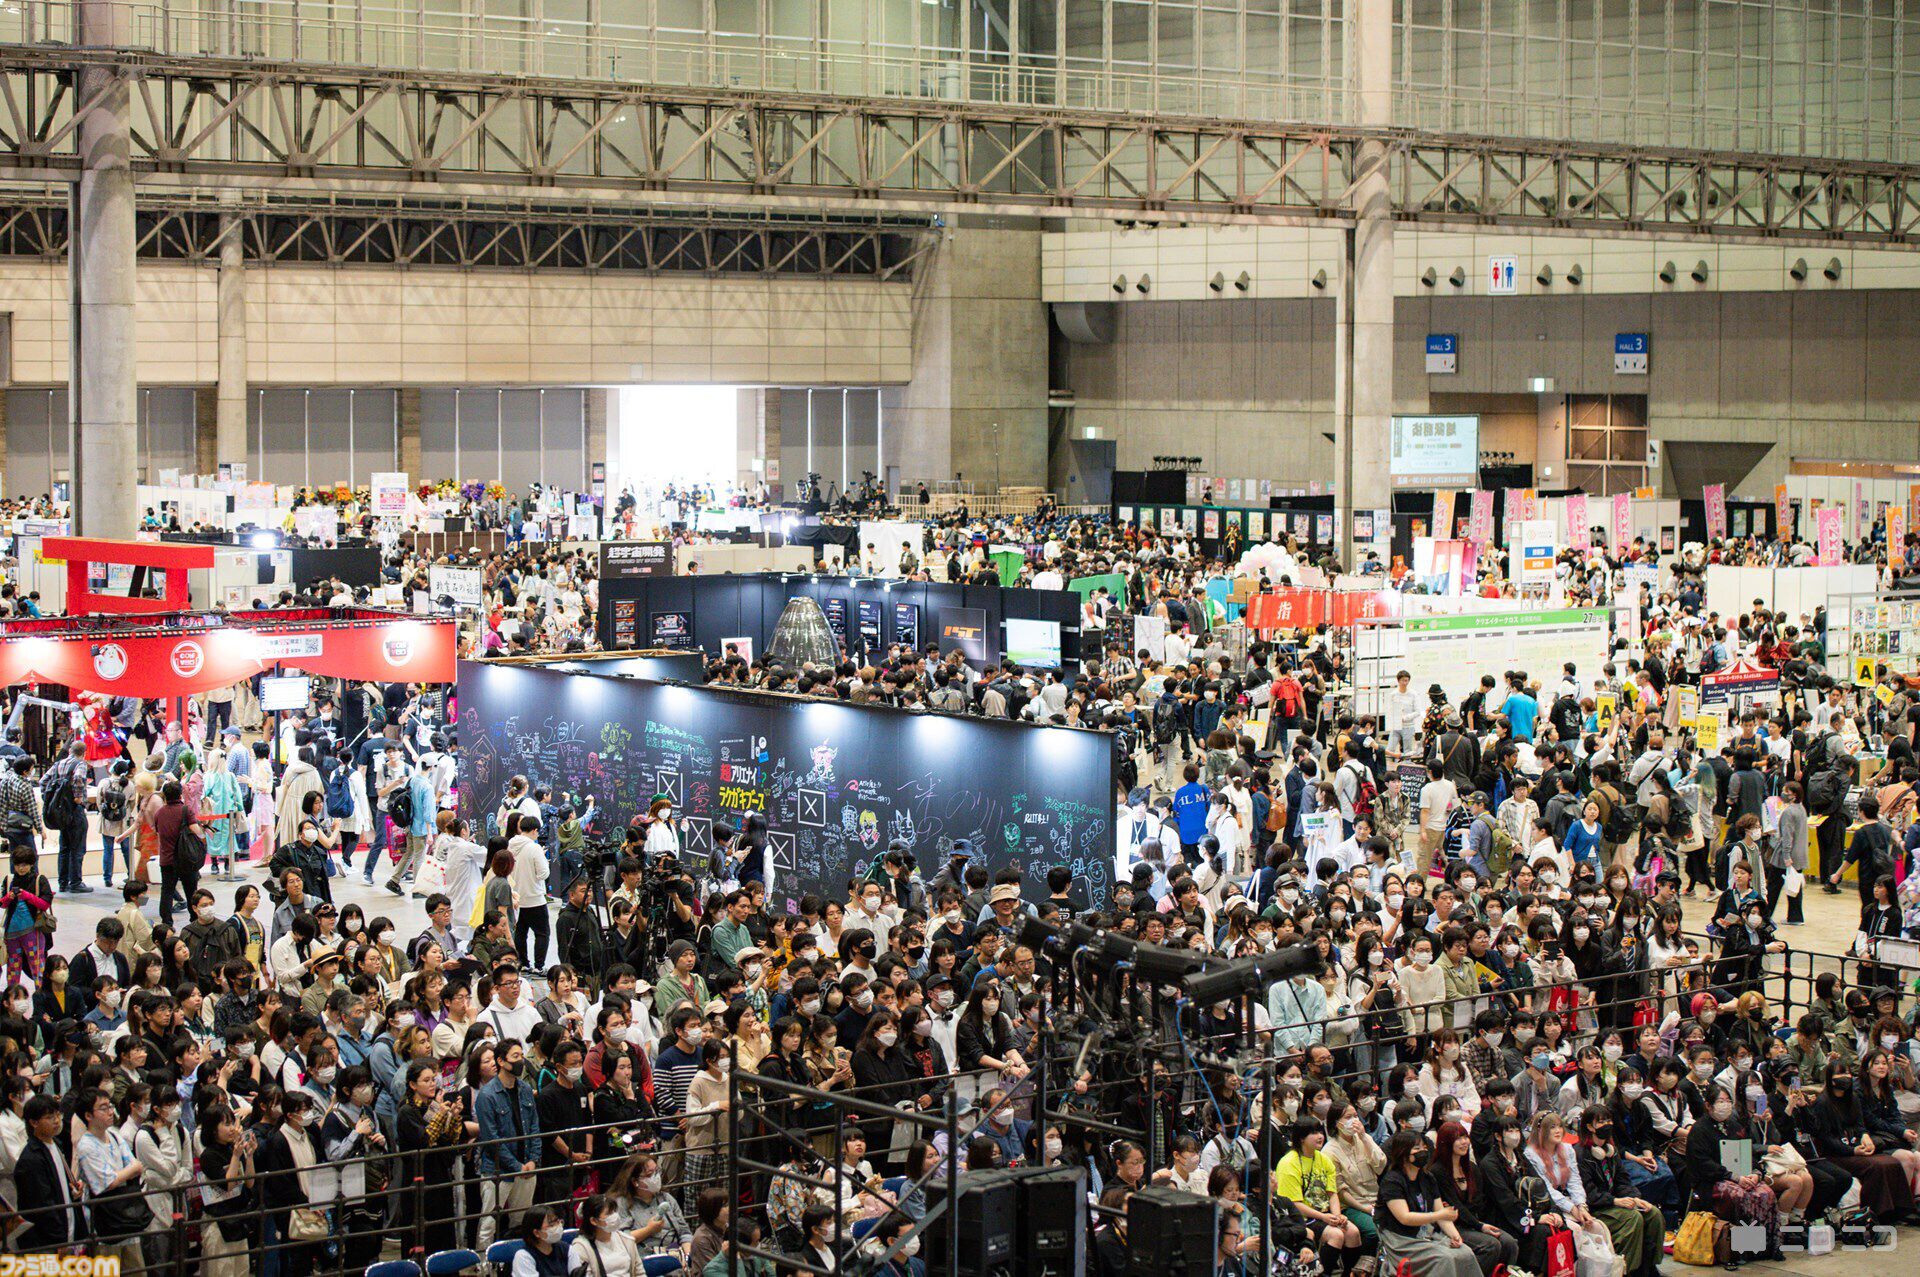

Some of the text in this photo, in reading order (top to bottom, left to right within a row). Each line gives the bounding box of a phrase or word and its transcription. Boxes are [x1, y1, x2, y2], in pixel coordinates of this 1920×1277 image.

[1444, 339, 1451, 351] 3
[1619, 338, 1643, 351] HALL 3
[1859, 665, 1872, 680] A
[1601, 705, 1612, 720] A
[719, 785, 766, 812] ラクガキブース
